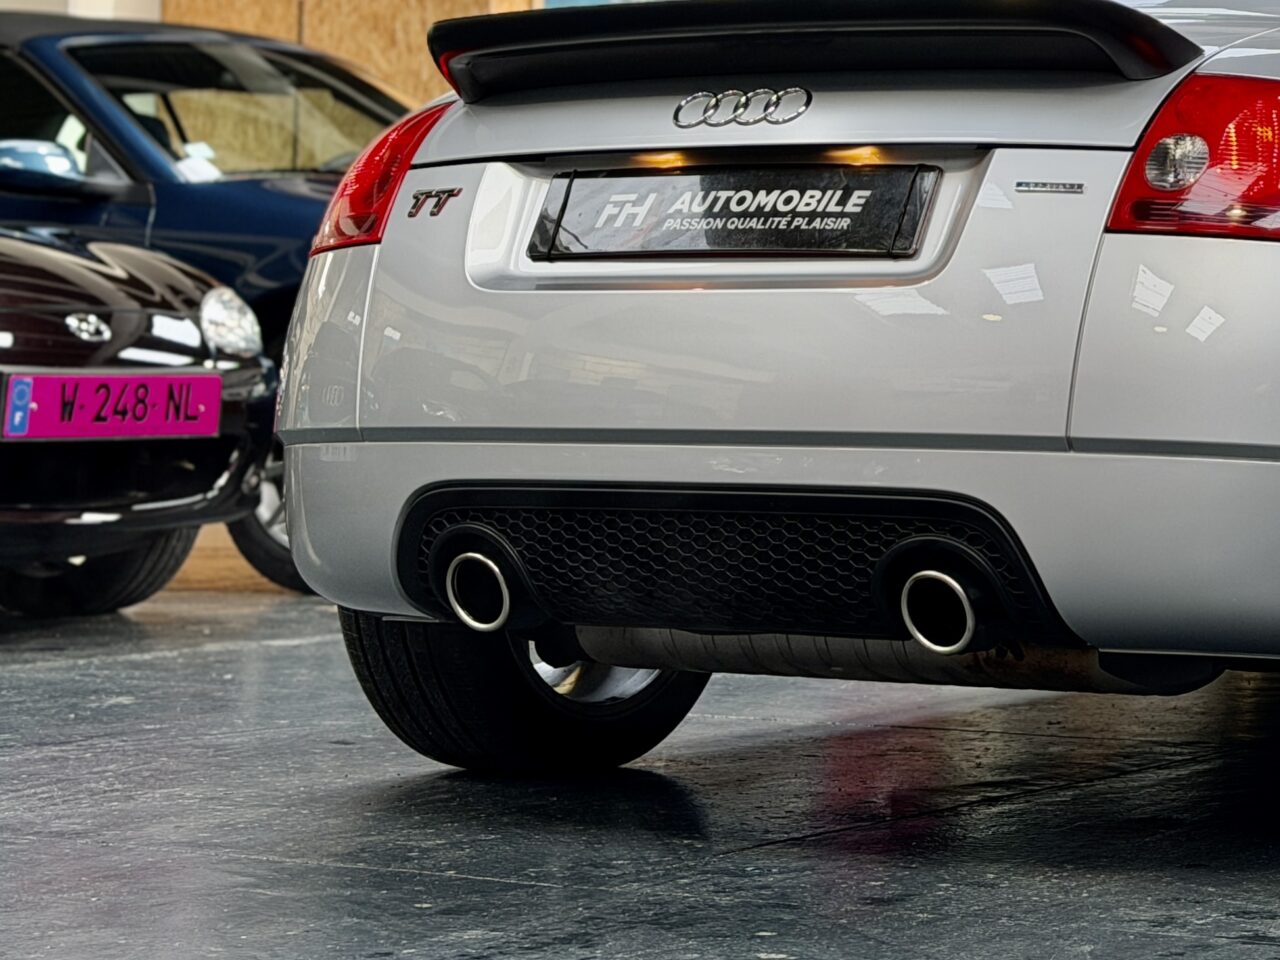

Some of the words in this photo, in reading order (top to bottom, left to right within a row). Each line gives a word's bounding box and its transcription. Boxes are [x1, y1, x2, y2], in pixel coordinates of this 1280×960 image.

[407, 187, 463, 218] TT
[595, 193, 656, 228] FH
[667, 190, 872, 213] AUTOMOBILE
[662, 217, 730, 231] PASSION
[727, 215, 792, 231] QUALITÉ
[789, 217, 851, 230] PLAISIR
